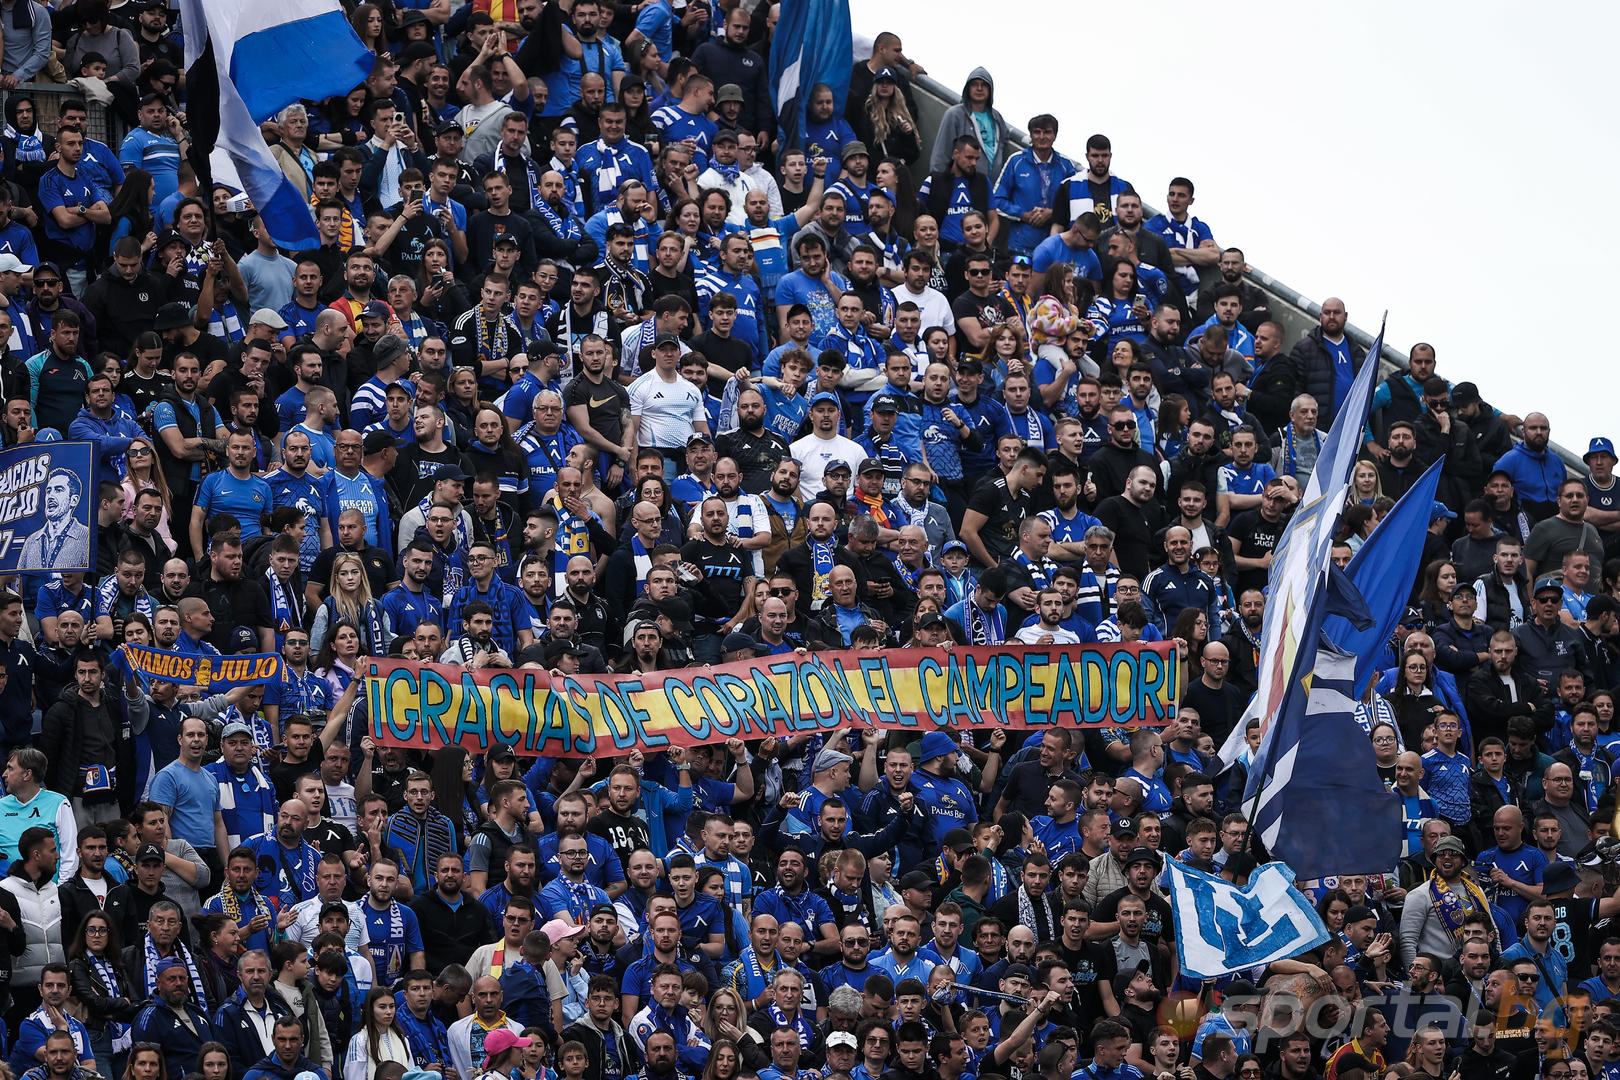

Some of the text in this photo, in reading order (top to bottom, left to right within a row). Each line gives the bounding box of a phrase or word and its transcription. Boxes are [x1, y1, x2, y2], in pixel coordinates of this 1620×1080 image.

[0, 453, 51, 494] ACIAS
[0, 530, 14, 559] 7
[132, 648, 194, 680] VAMOS
[211, 655, 278, 682] JULIO
[594, 679, 670, 750] DE
[857, 655, 919, 727] EL
[917, 648, 1177, 727] CAMPEADOR!
